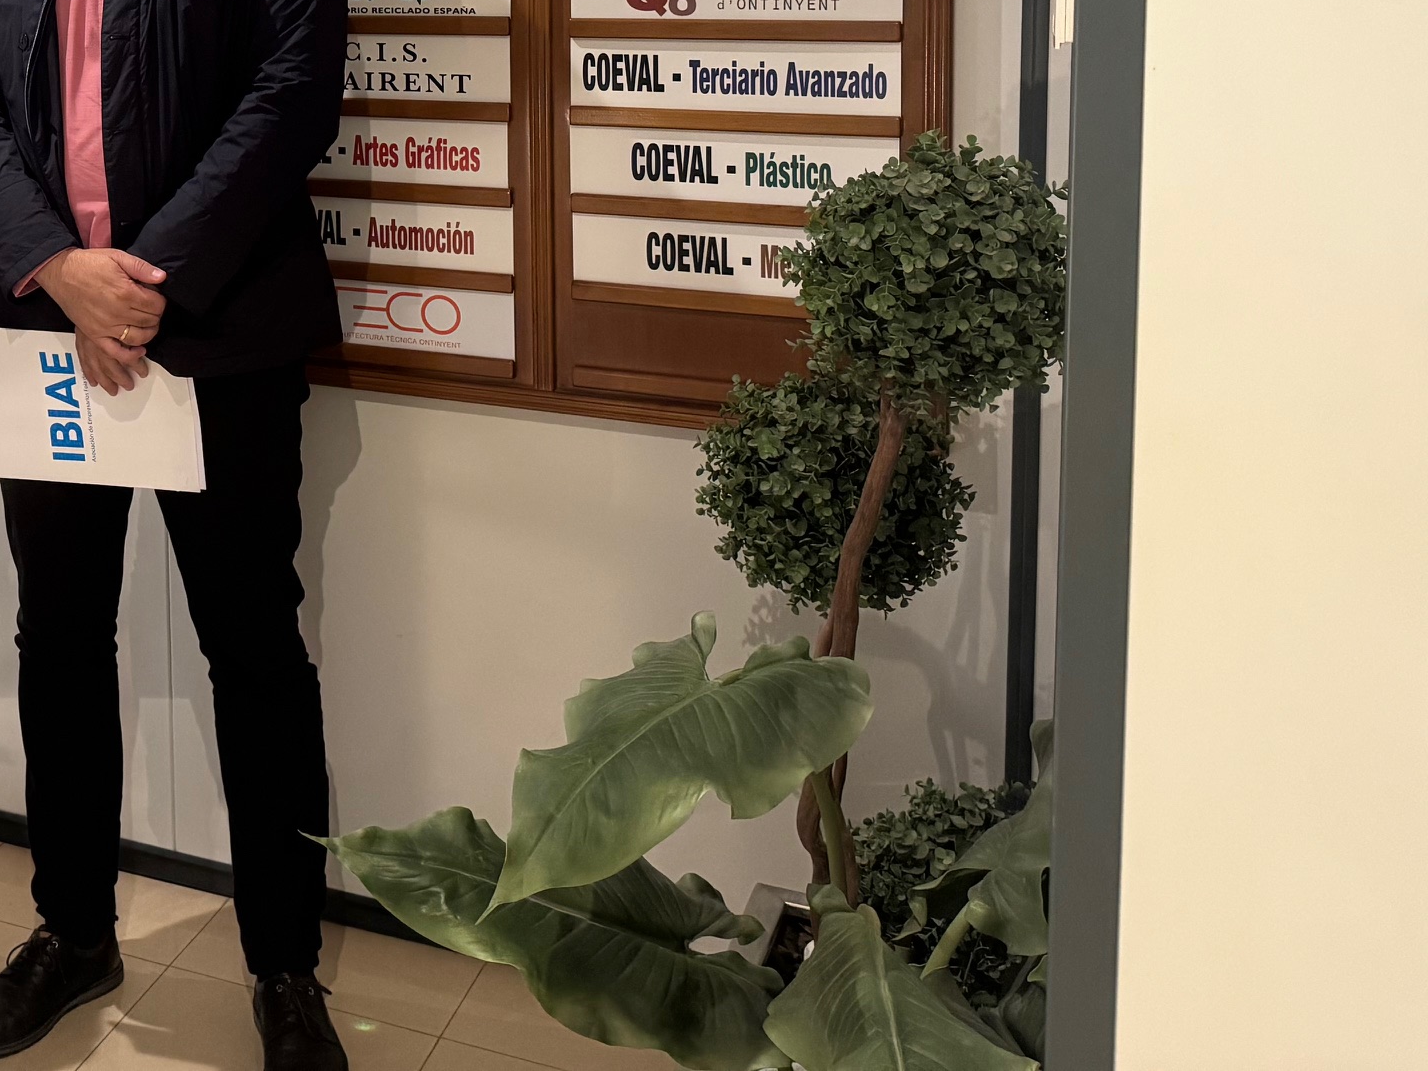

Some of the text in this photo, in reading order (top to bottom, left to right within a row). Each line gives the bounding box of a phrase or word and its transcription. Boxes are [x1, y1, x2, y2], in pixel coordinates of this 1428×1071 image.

[372, 6, 431, 15] RECICLADO
[433, 5, 477, 15] ESPAÑA
[582, 52, 888, 100] COEVAL - Terciario Avanzado
[352, 135, 399, 168] Artes
[404, 136, 481, 172] Gráficas
[631, 142, 833, 191] COEVAL - Plástico
[367, 216, 475, 255] Automoción
[646, 231, 734, 276] COEVAL
[742, 257, 752, 266] -
[418, 338, 461, 348] ONTINYENT
[38, 351, 86, 462] IBIAE
[85, 392, 93, 425] Empresarios
[88, 425, 94, 433] de
